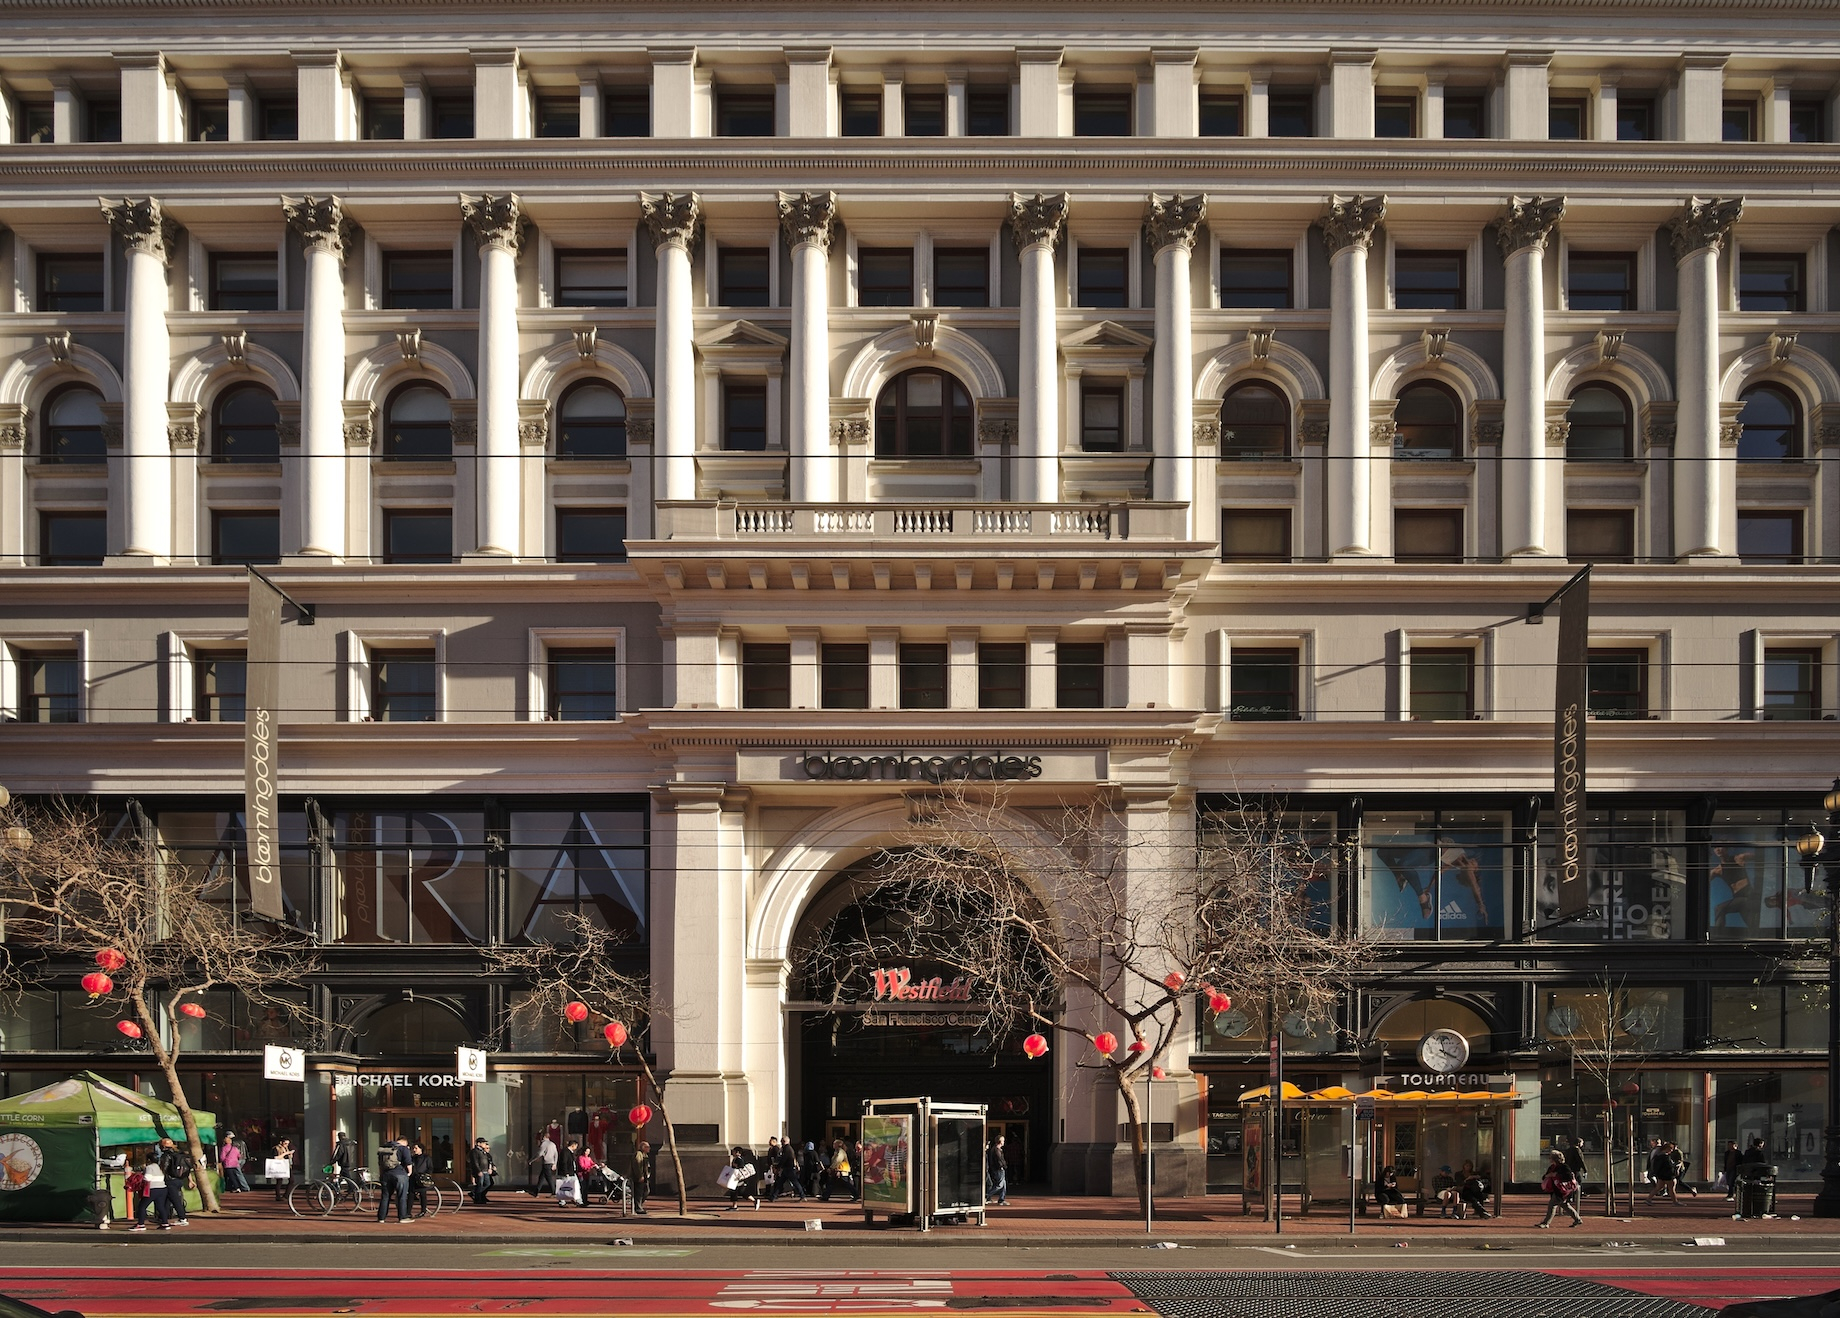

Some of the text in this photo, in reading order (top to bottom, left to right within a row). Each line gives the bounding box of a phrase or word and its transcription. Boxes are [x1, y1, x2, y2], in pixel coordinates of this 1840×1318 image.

[1602, 870, 1623, 940] HERE
[1626, 903, 1649, 940] TO
[870, 967, 974, 1001] Westfield
[863, 1012, 887, 1027] San
[888, 1012, 947, 1027] Francisco
[339, 1074, 466, 1087] MICHAEL KORS
[1400, 1074, 1489, 1086] TOURNEAU
